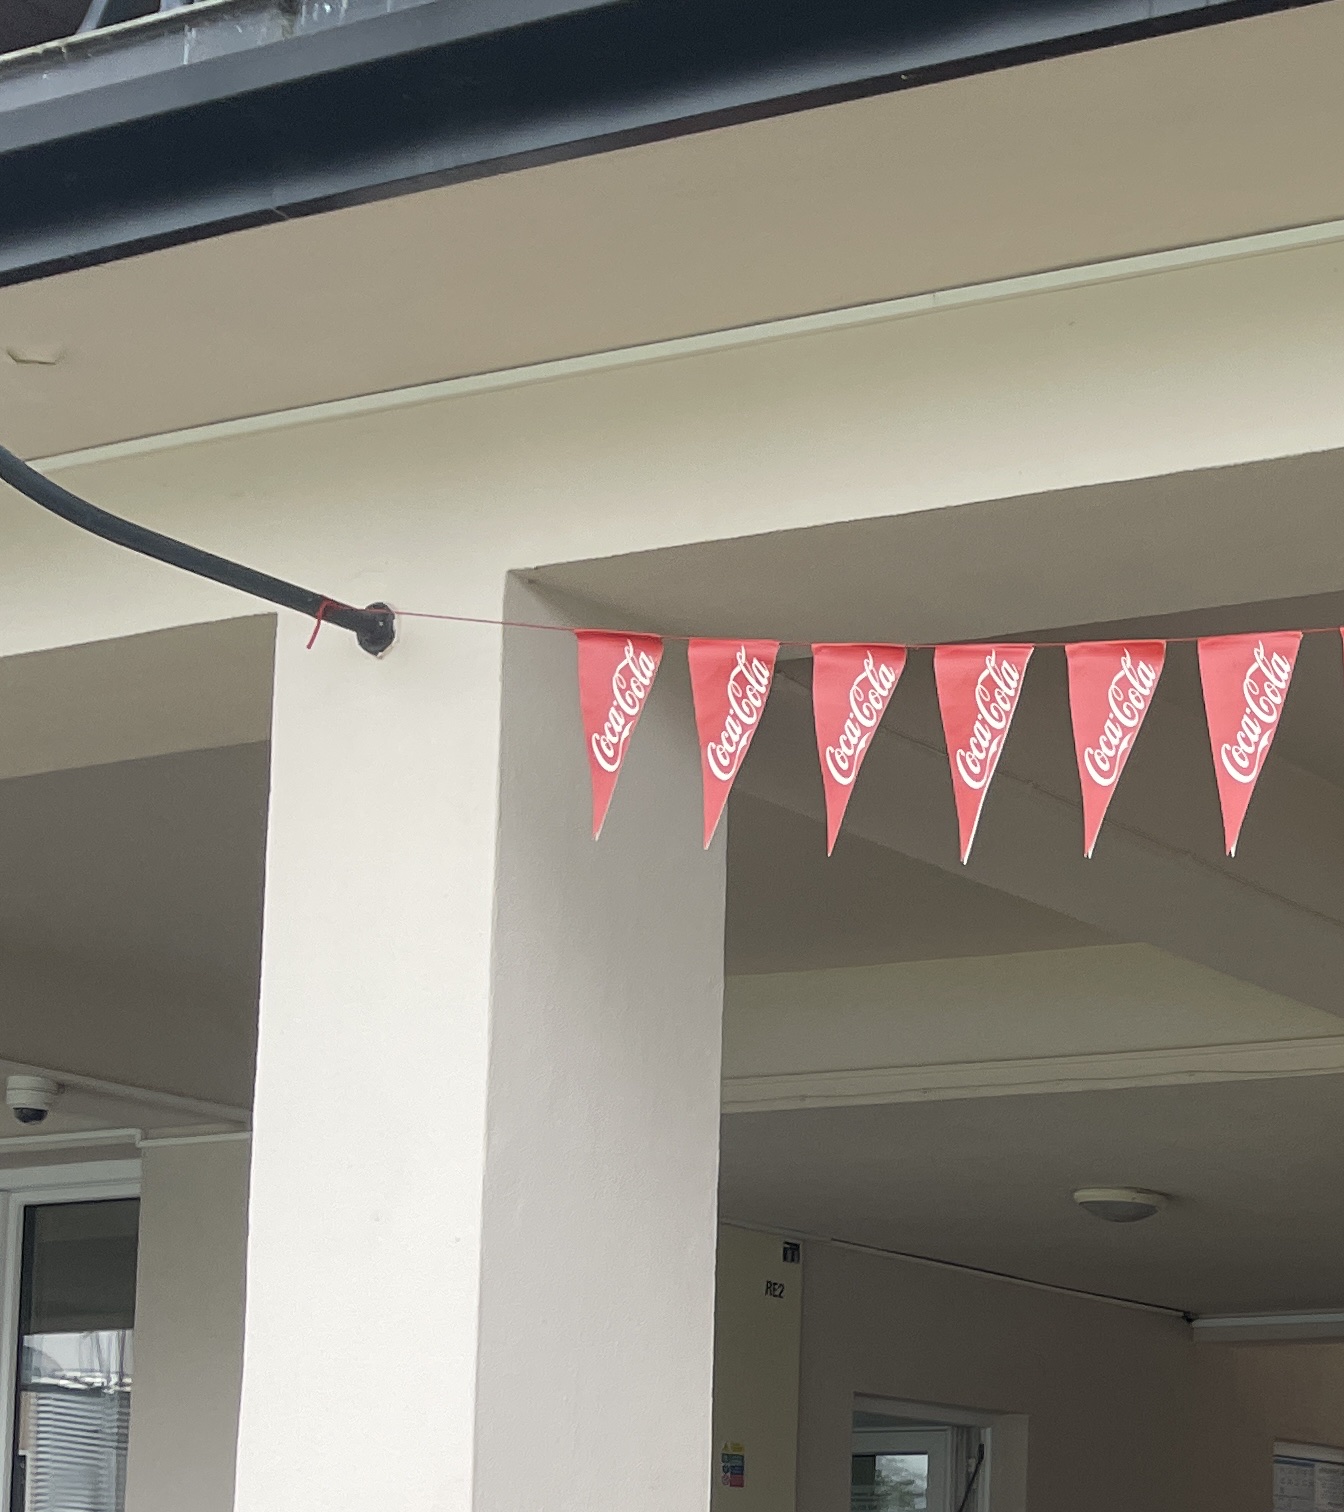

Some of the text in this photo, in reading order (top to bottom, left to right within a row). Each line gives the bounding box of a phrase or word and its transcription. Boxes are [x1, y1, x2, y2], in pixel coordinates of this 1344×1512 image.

[591, 640, 656, 773] Coca-Cola
[706, 645, 770, 781] Coca-Cola
[825, 651, 897, 786] Coca-Cola
[955, 648, 1019, 789] Coca-Cola
[1083, 648, 1156, 787] Coca-Cola
[1220, 639, 1292, 784] Coca-Cola
[764, 1280, 785, 1299] RE2
